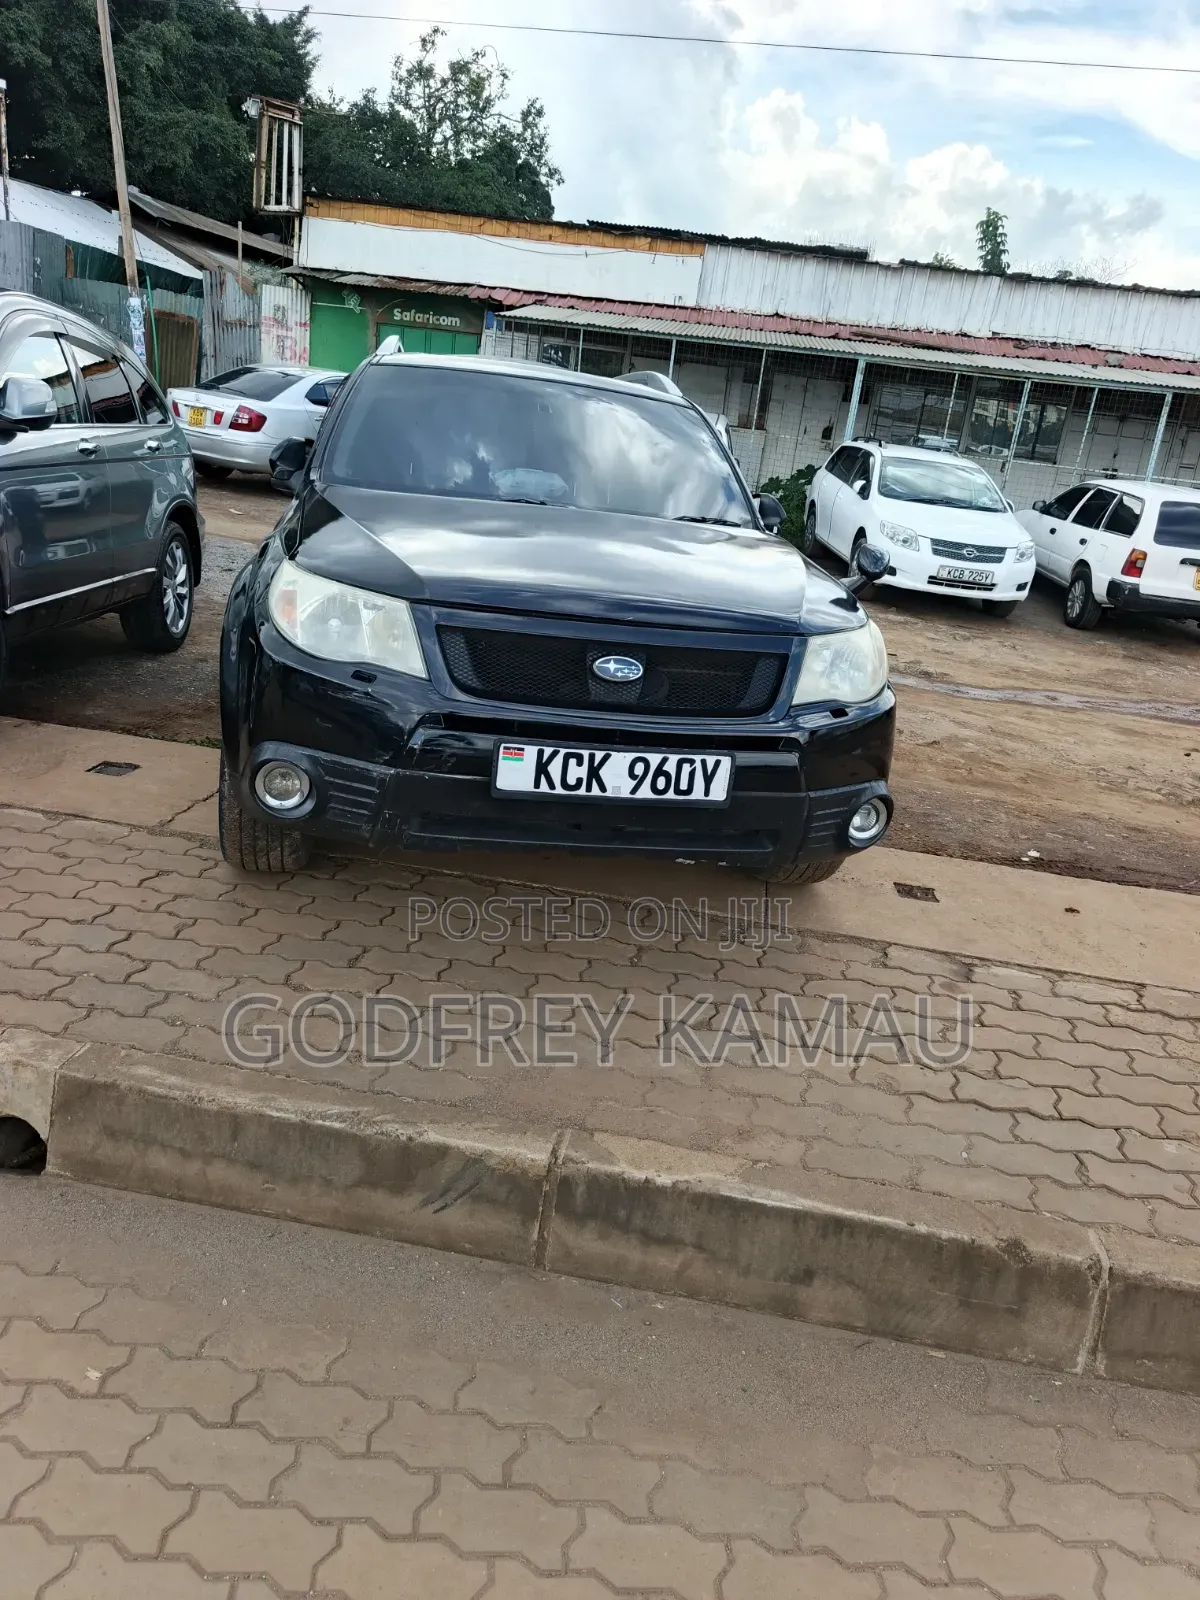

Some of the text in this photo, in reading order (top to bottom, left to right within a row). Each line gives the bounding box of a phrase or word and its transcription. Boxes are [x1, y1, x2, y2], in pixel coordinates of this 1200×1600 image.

[393, 308, 461, 327] Safaricom
[947, 568, 990, 583] KCB 725Y
[533, 747, 612, 794] KCK
[627, 755, 722, 798] 960Y
